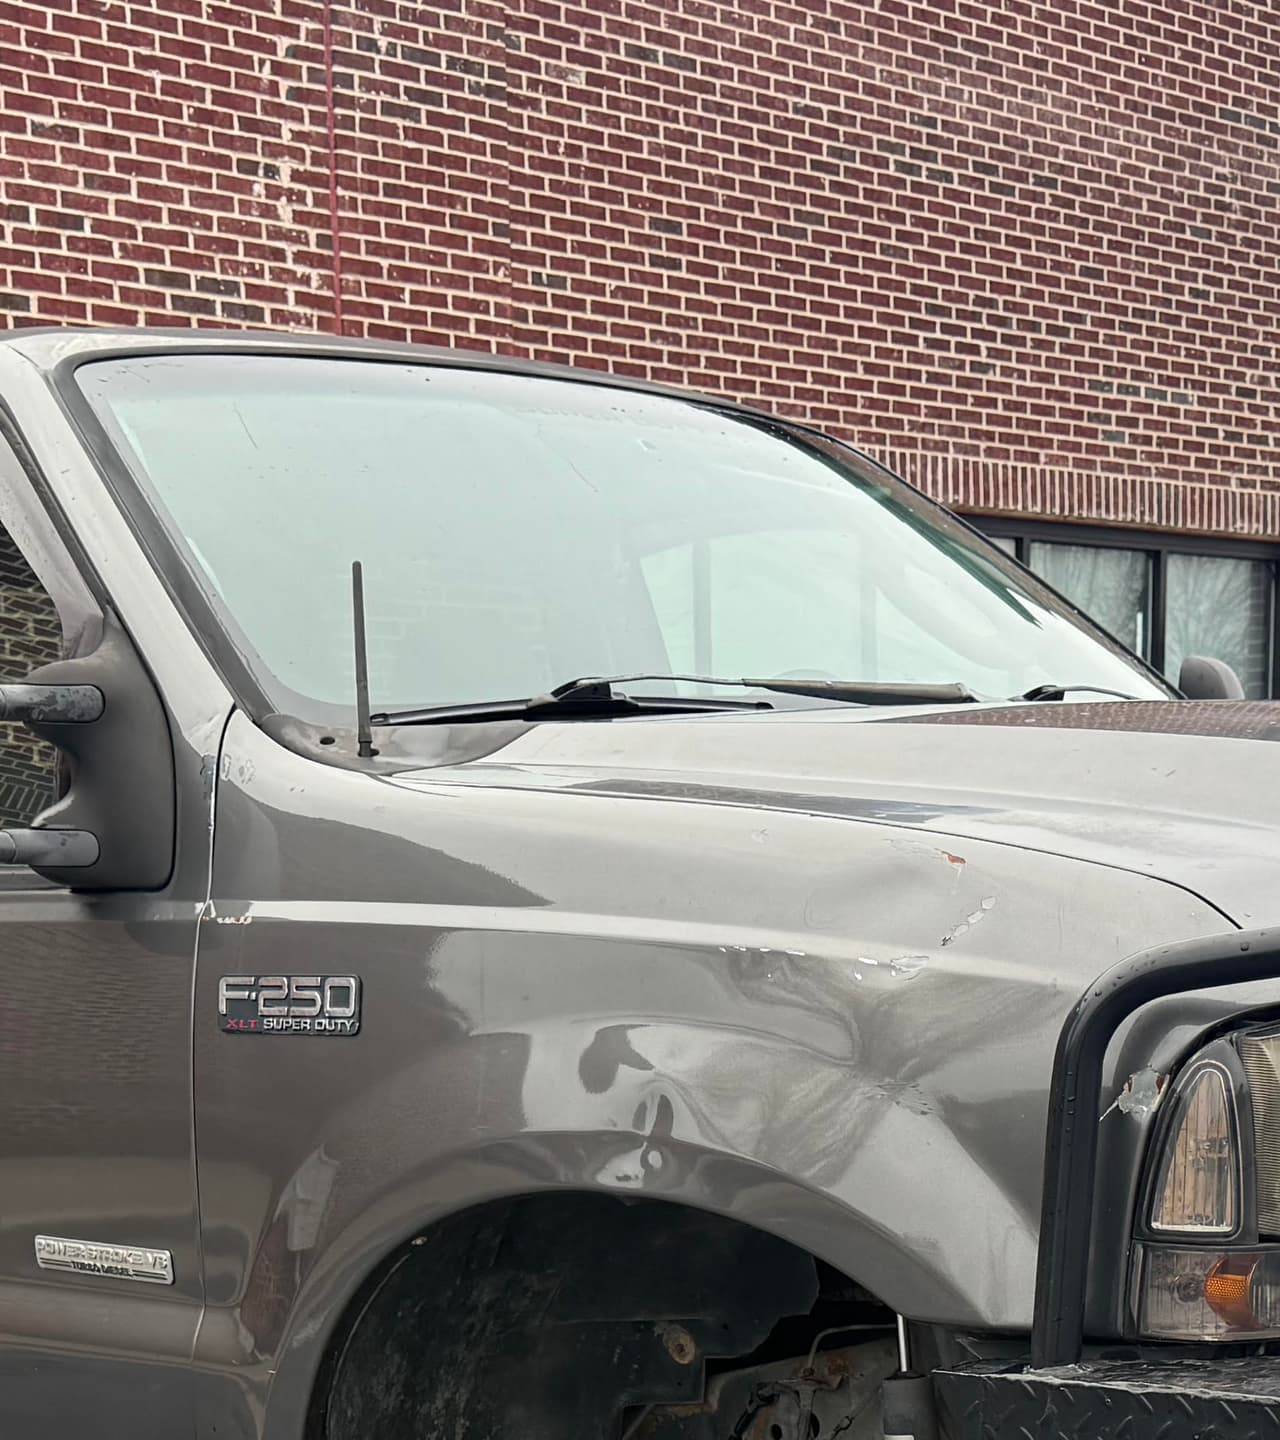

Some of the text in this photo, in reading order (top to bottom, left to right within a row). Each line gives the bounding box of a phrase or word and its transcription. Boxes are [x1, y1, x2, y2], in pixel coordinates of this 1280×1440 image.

[218, 976, 357, 1017] F-250
[226, 1017, 355, 1033] XLT SUPER DUTY
